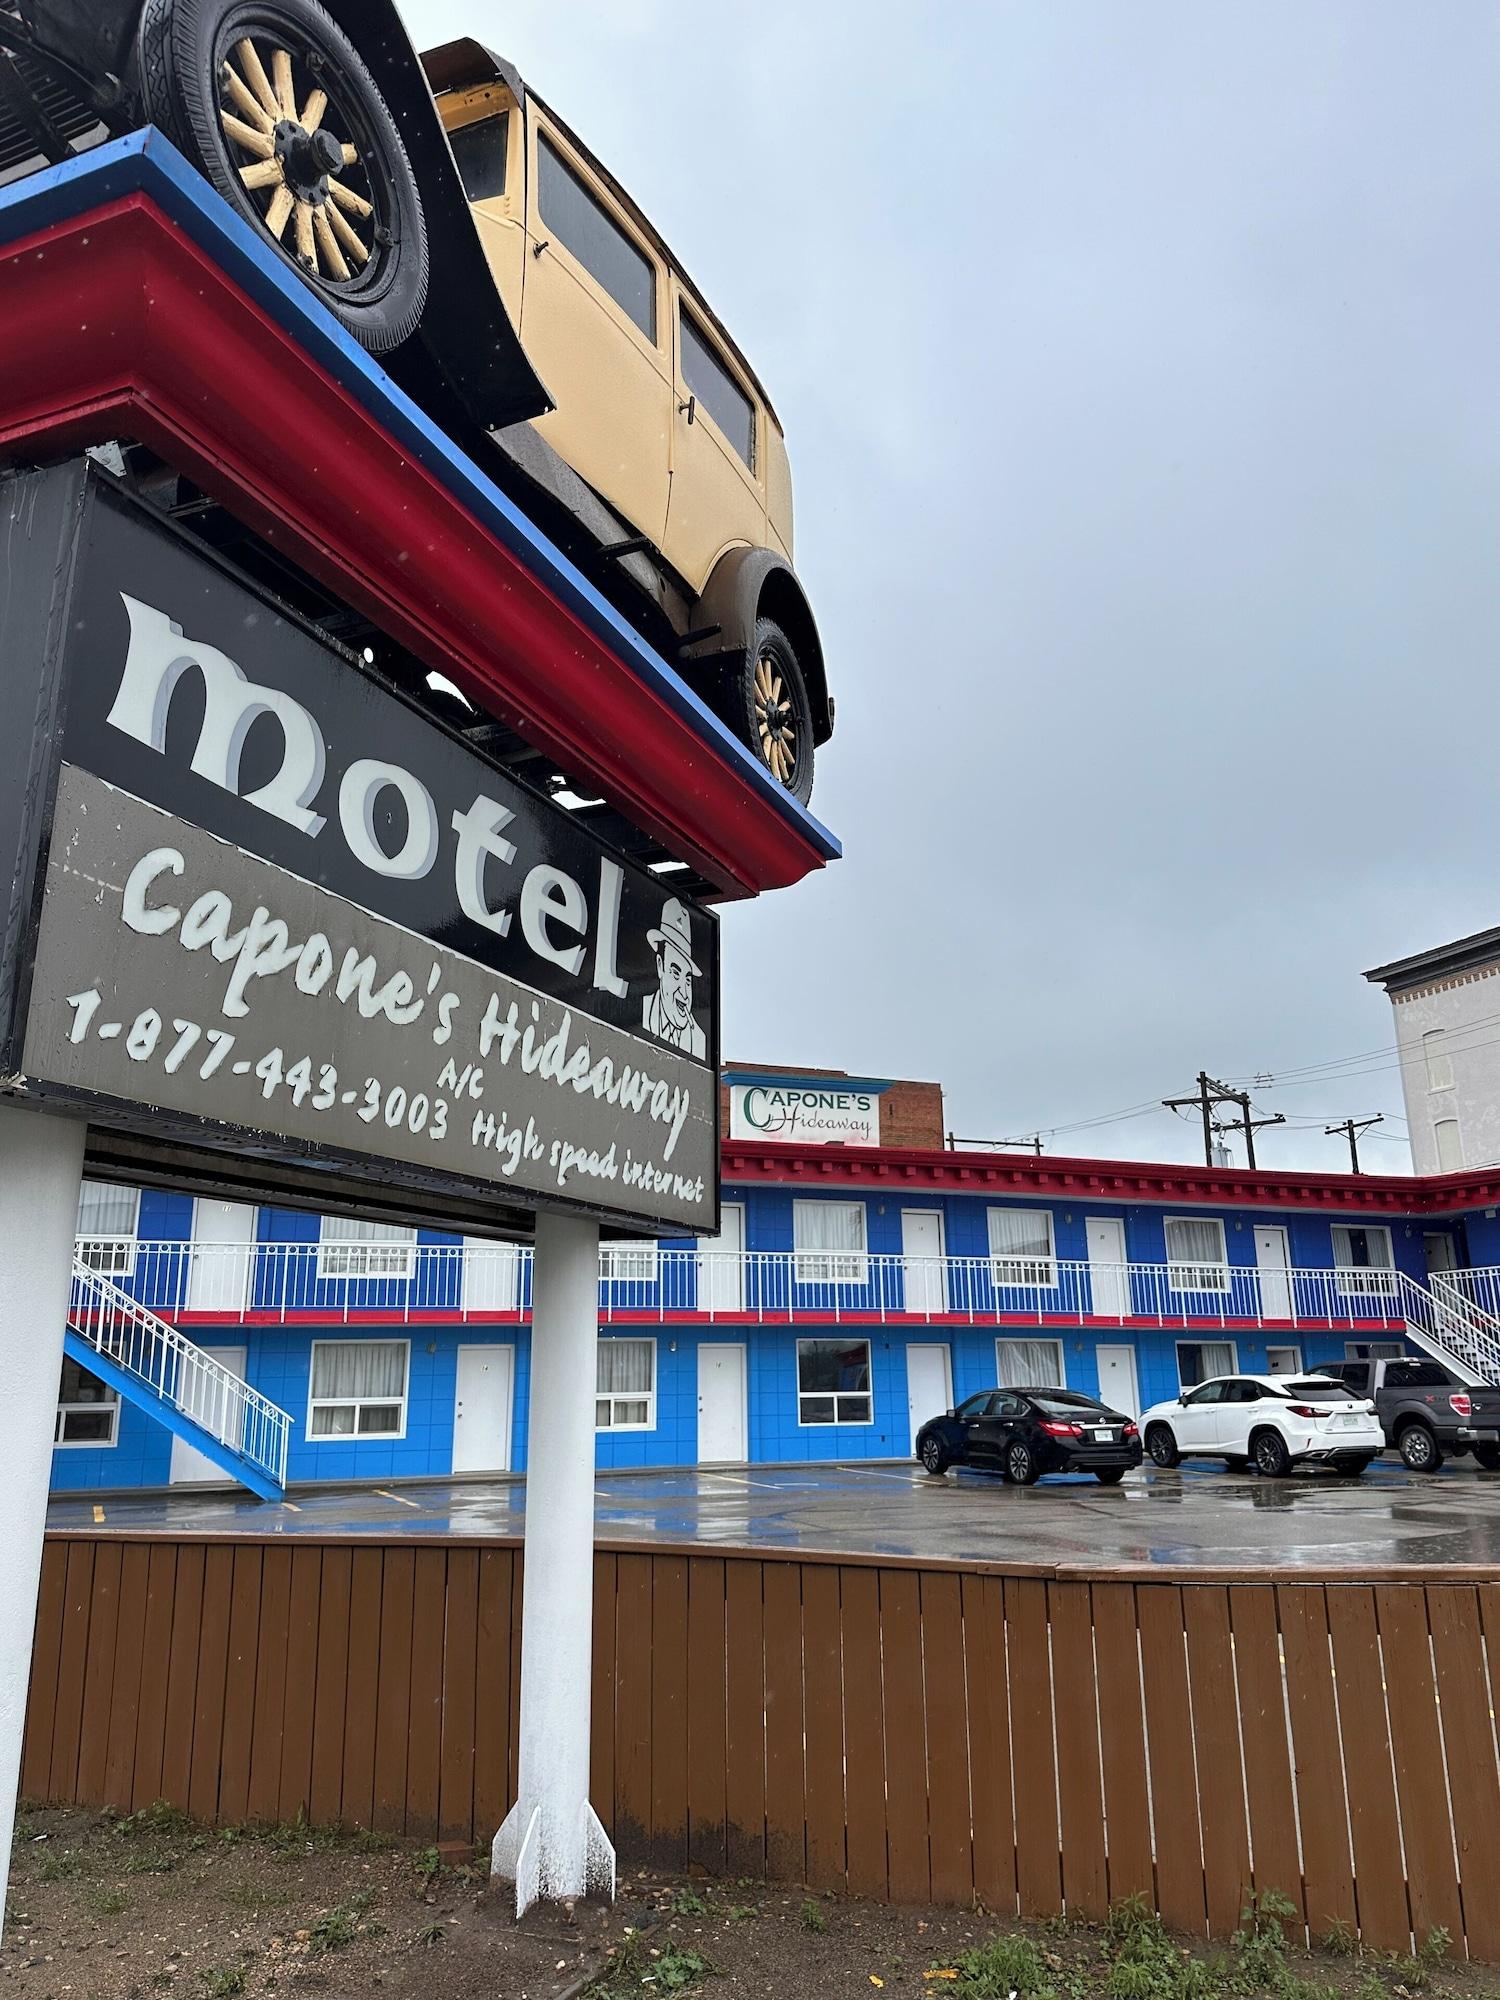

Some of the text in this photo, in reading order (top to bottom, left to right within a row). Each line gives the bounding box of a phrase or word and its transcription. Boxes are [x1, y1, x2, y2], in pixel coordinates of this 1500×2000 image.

[107, 591, 629, 998] motel
[66, 987, 449, 1140] 1-877-443-3003
[122, 847, 691, 1162] Capone's Hideaway
[436, 1056, 484, 1100] A/C
[762, 1105, 872, 1140] Hideaway
[471, 1108, 705, 1204] High speed internet
